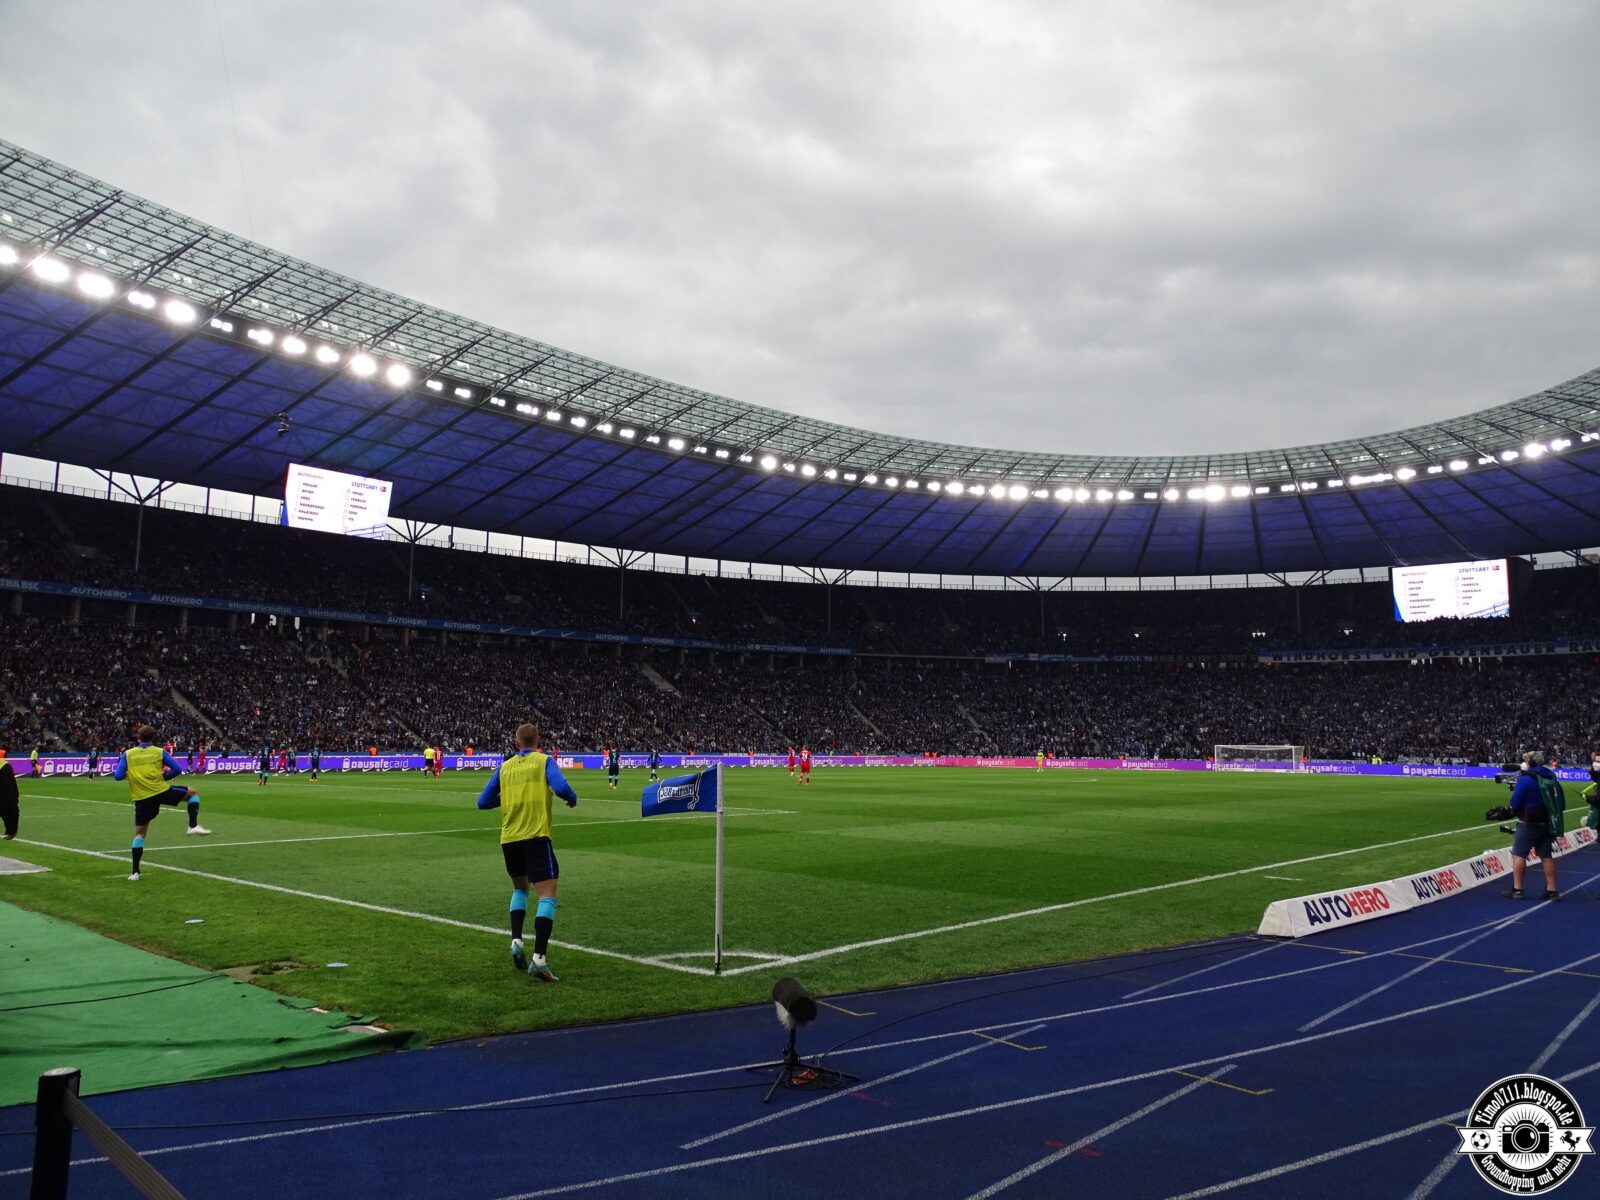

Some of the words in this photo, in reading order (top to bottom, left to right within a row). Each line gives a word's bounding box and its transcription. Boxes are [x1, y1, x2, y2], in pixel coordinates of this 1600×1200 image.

[70, 586, 127, 599] AUTOHERO
[151, 594, 203, 606] AUTOHERO
[387, 616, 427, 626] AUTOHERO
[443, 621, 481, 631] AUTOHERO
[595, 633, 629, 642] AUTOHERO
[642, 637, 674, 646] AUTOHERO
[1271, 649, 1371, 662] WINDHORST
[1382, 647, 1417, 660] UND
[1429, 641, 1556, 657] GEGENBAUER
[351, 758, 409, 769] paysafecard
[982, 758, 1016, 767] paysafecard
[1051, 759, 1088, 768] paysafecard
[1127, 760, 1168, 770] paysafecard
[1411, 766, 1467, 777] paysafecard
[1470, 856, 1505, 881] AUTOHERO
[1410, 870, 1463, 900] AUTOHERO
[1303, 887, 1390, 926] AUTOHERO
